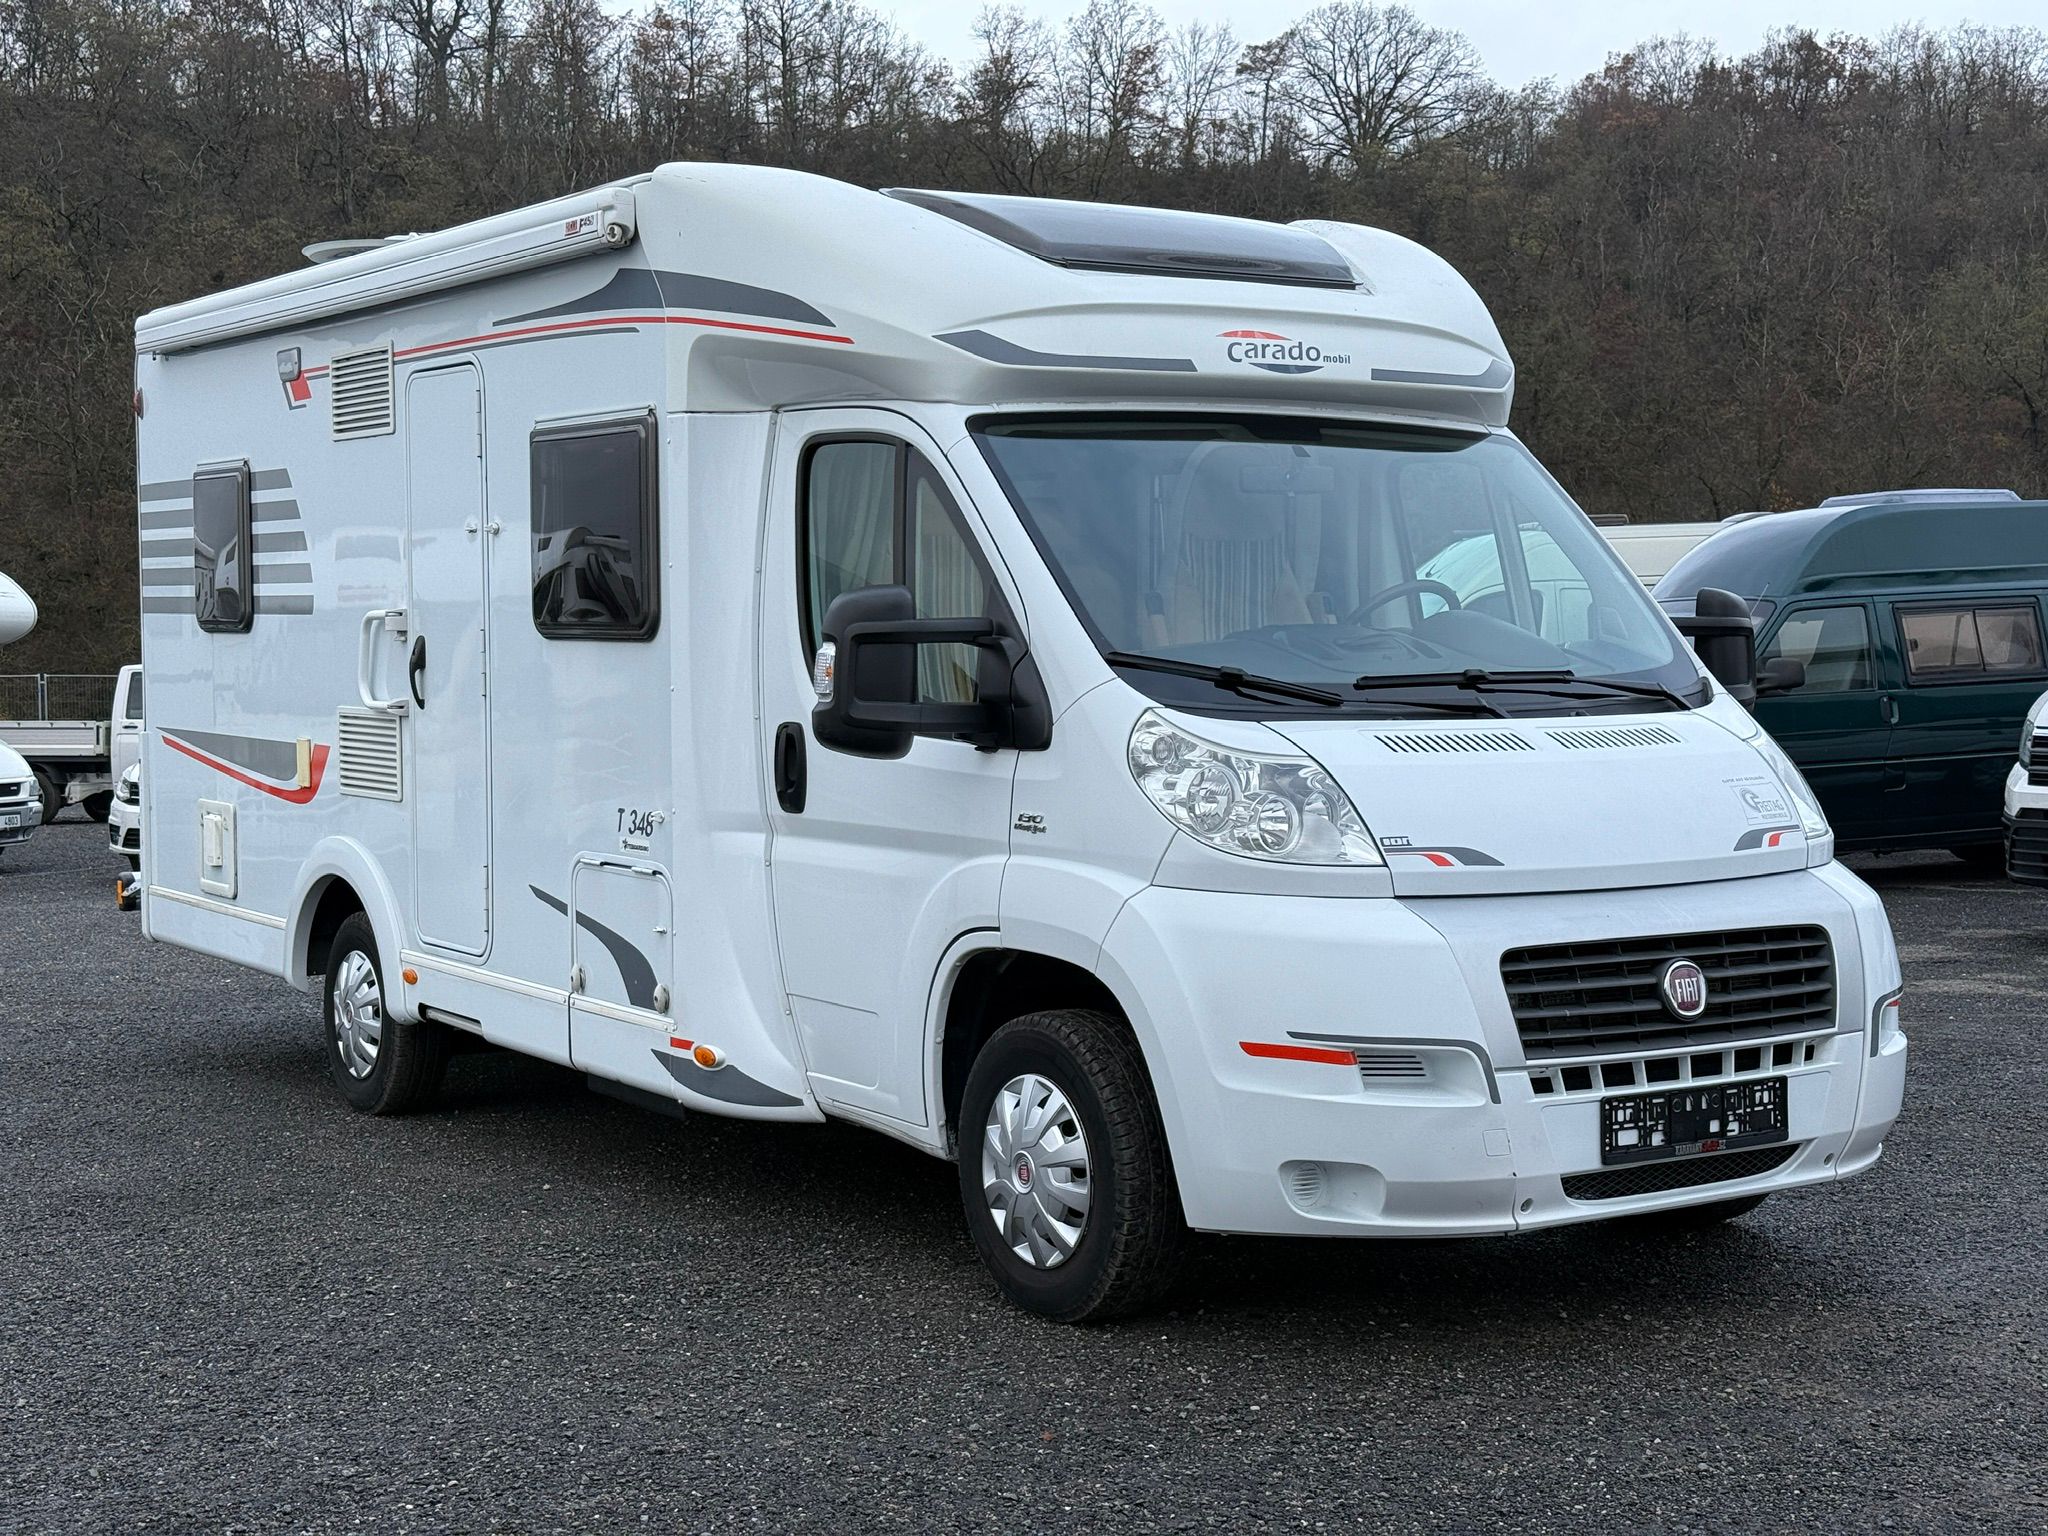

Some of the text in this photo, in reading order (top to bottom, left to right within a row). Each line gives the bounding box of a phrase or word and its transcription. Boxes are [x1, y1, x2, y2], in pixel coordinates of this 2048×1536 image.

[1322, 354, 1351, 364] mobil
[617, 807, 654, 838] T 348
[1674, 977, 1699, 1003] FIAT
